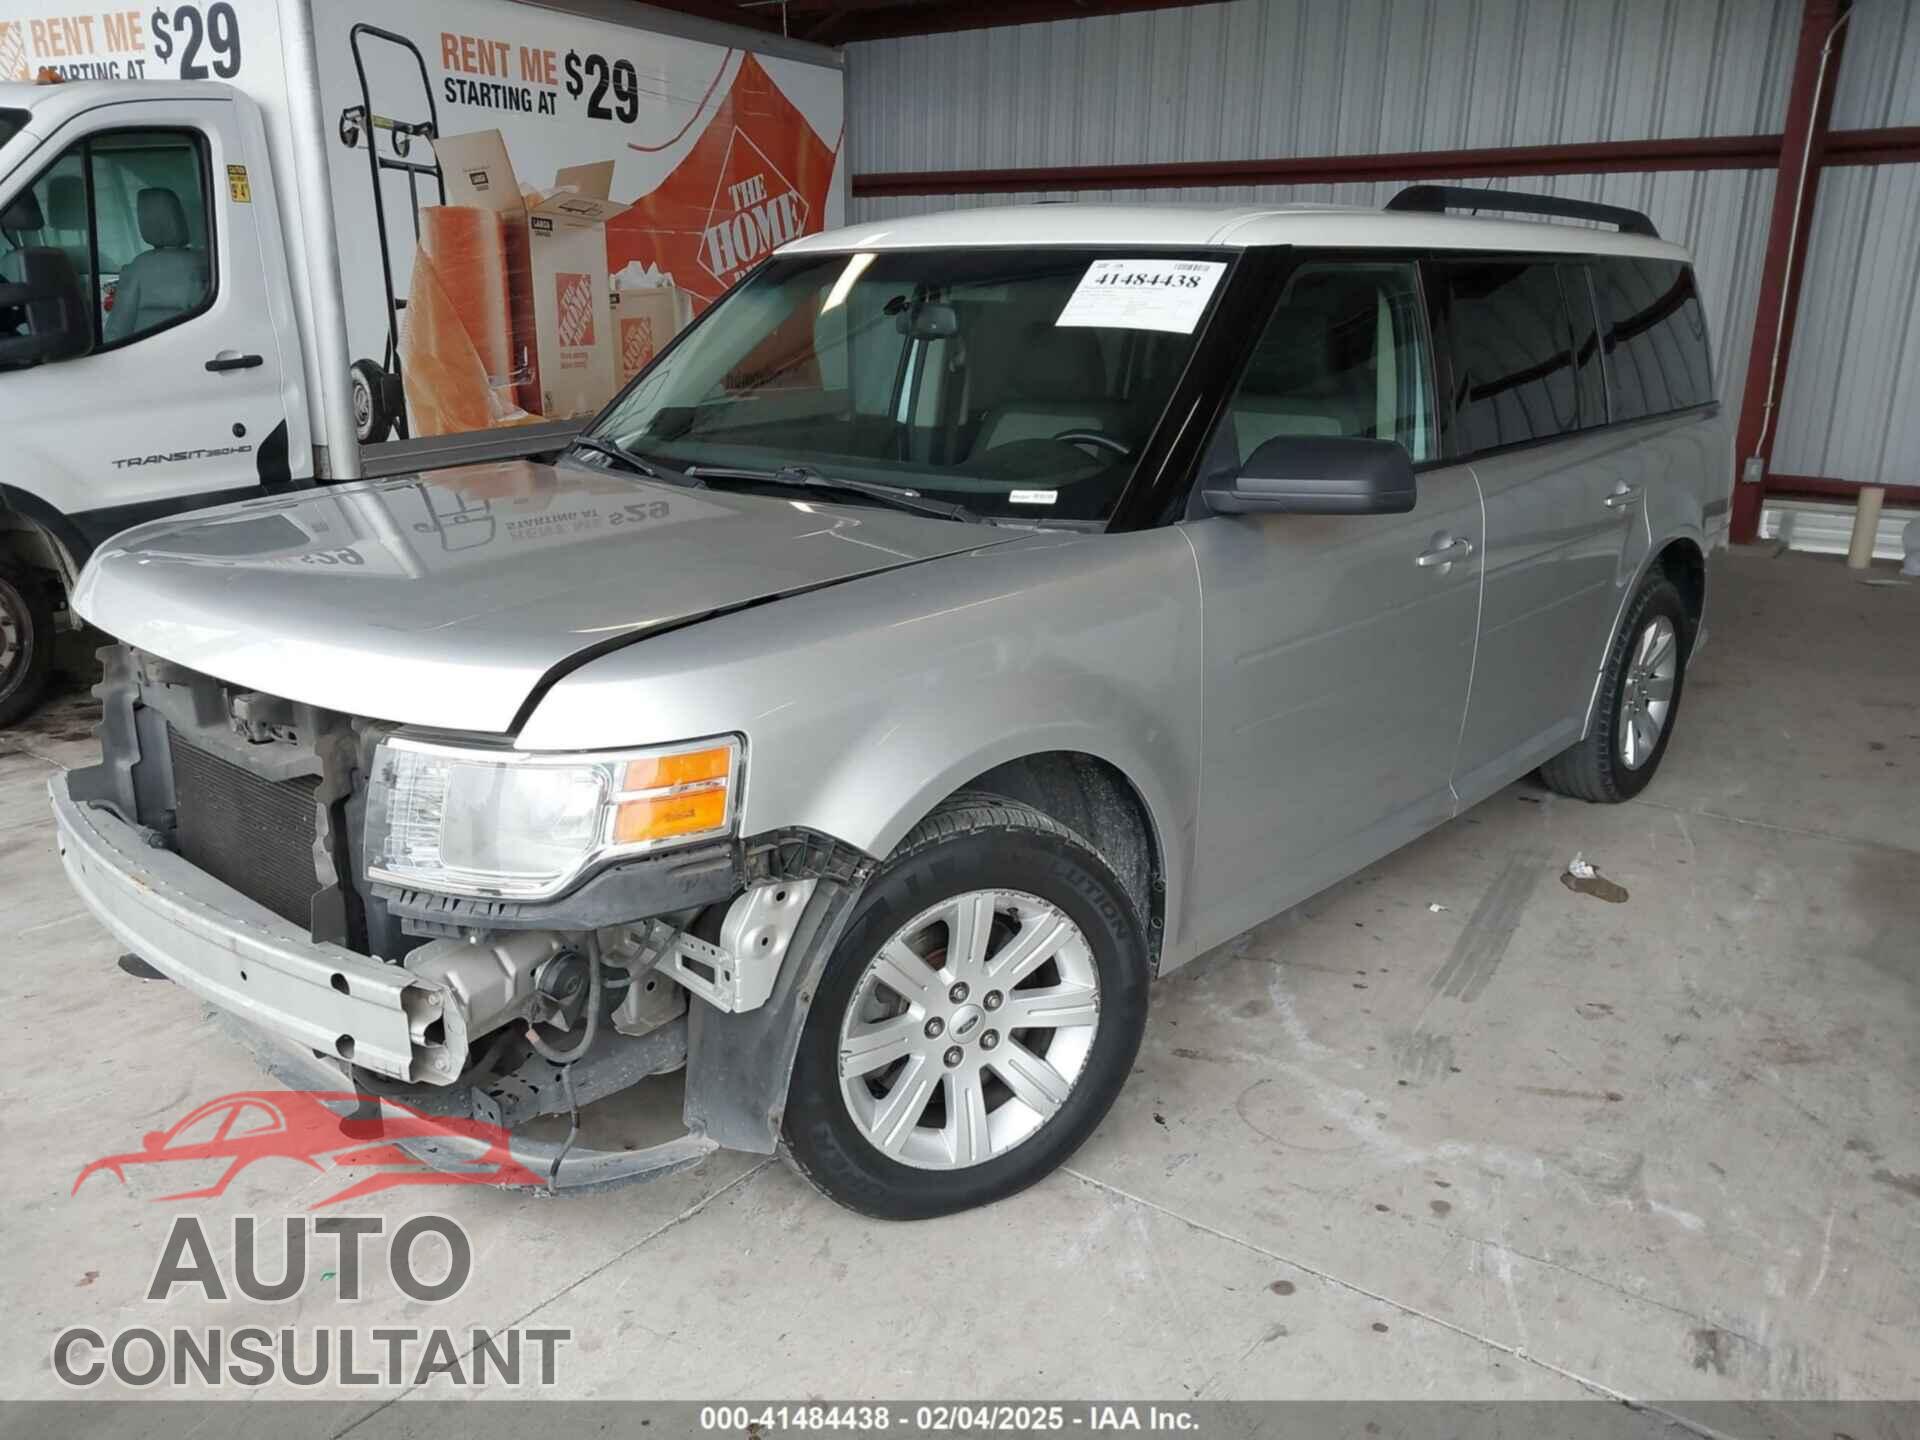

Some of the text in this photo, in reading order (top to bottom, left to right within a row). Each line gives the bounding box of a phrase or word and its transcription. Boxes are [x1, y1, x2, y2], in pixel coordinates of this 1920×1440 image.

[30, 15, 94, 57] RENT
[102, 11, 145, 52] ME
[152, 2, 241, 79] $29
[127, 59, 145, 80] AT
[440, 32, 558, 86] RENT ME
[444, 77, 557, 116] STARTING AT
[565, 49, 639, 124] $29
[728, 174, 767, 212] THE
[705, 191, 804, 276] HOME
[1095, 273, 1201, 288] 41484438
